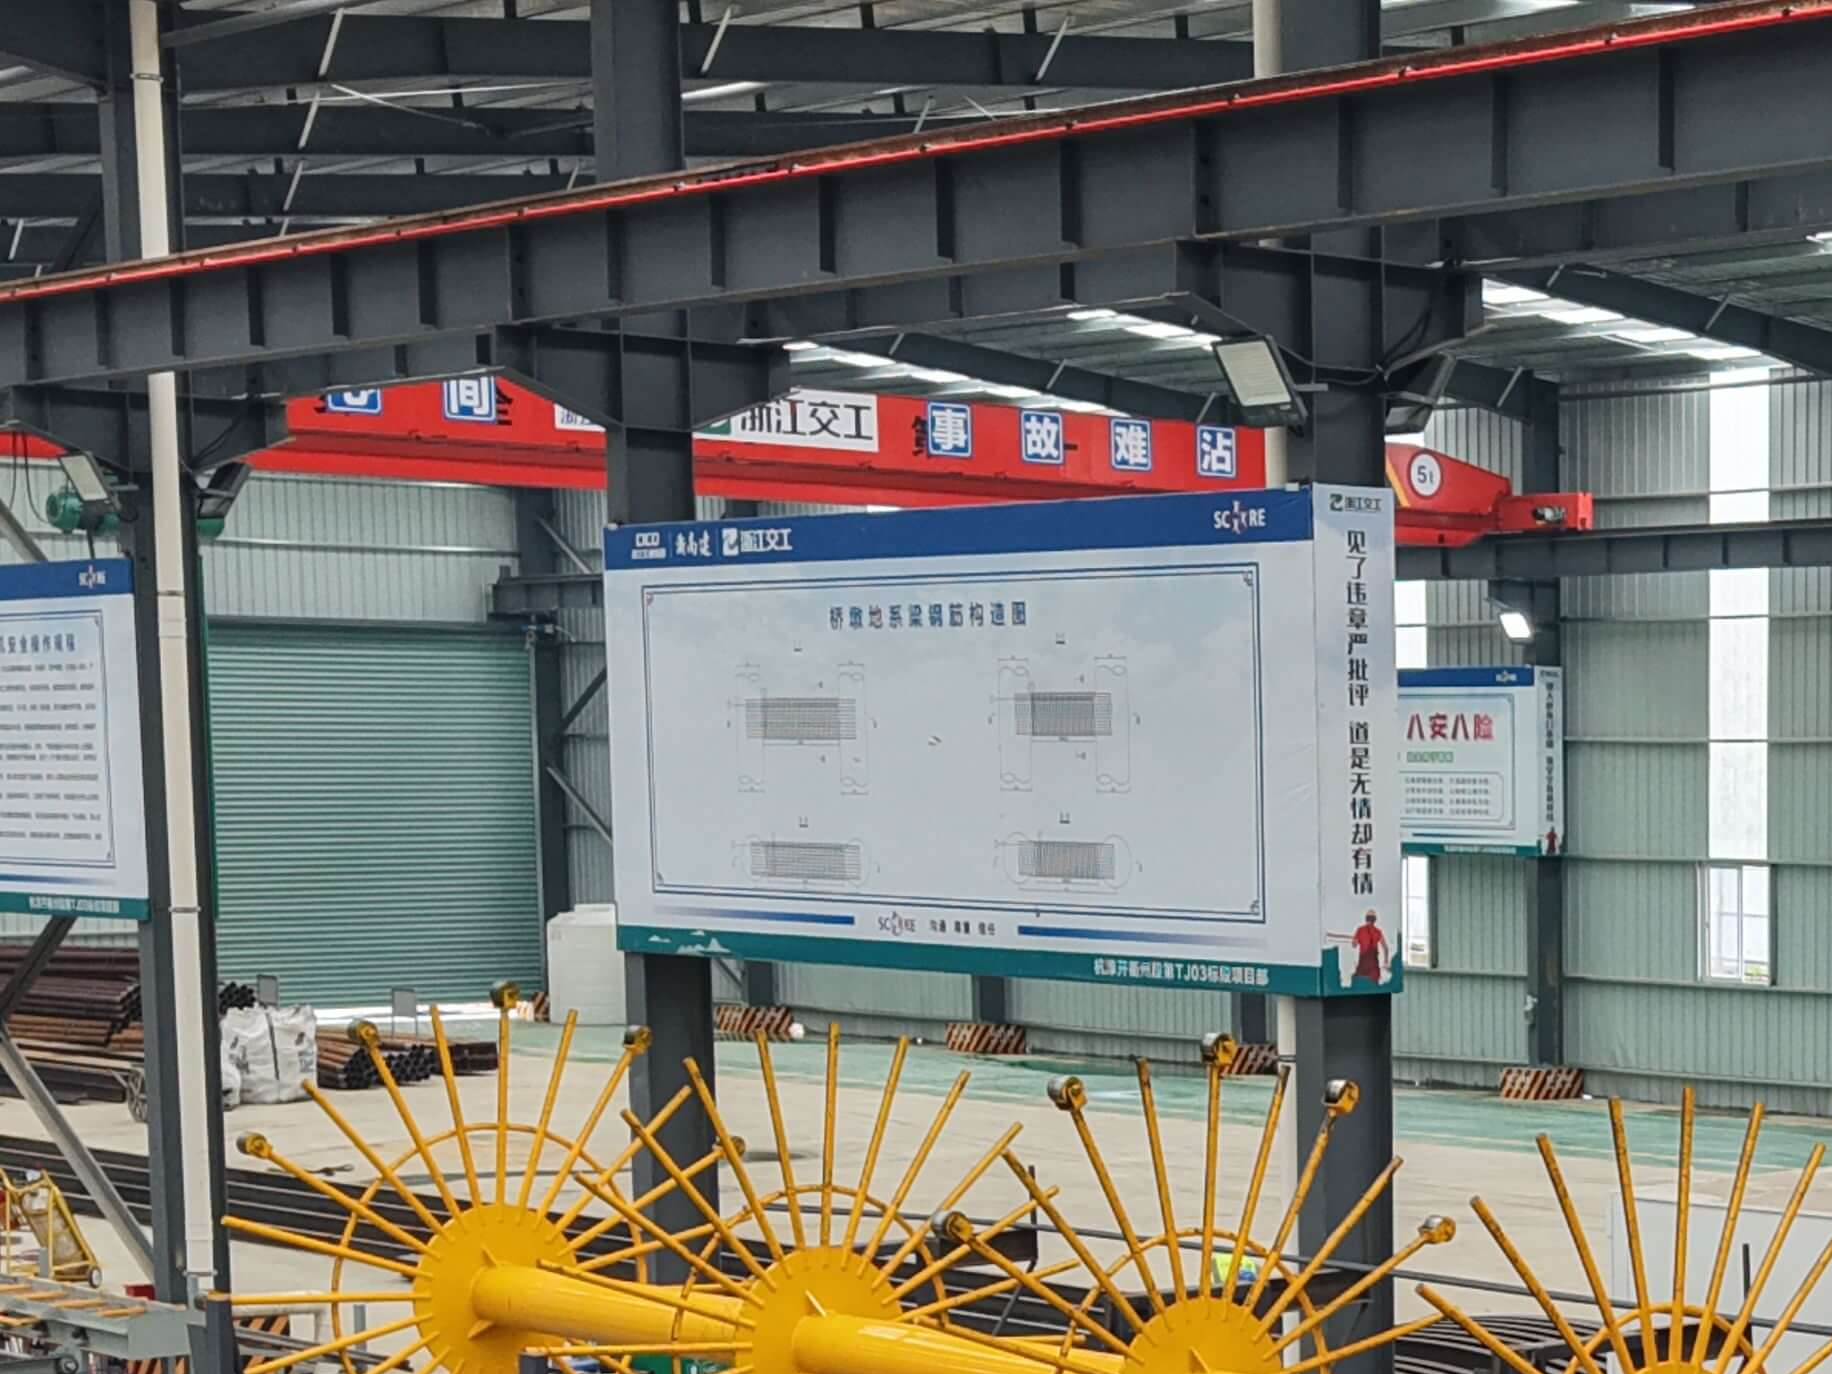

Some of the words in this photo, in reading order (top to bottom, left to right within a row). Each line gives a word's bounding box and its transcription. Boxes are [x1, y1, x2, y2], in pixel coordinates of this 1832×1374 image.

[741, 399, 873, 440] 浙江交工
[932, 406, 1234, 474] 事故难沾
[1349, 721, 1374, 895] 道是无情却有情
